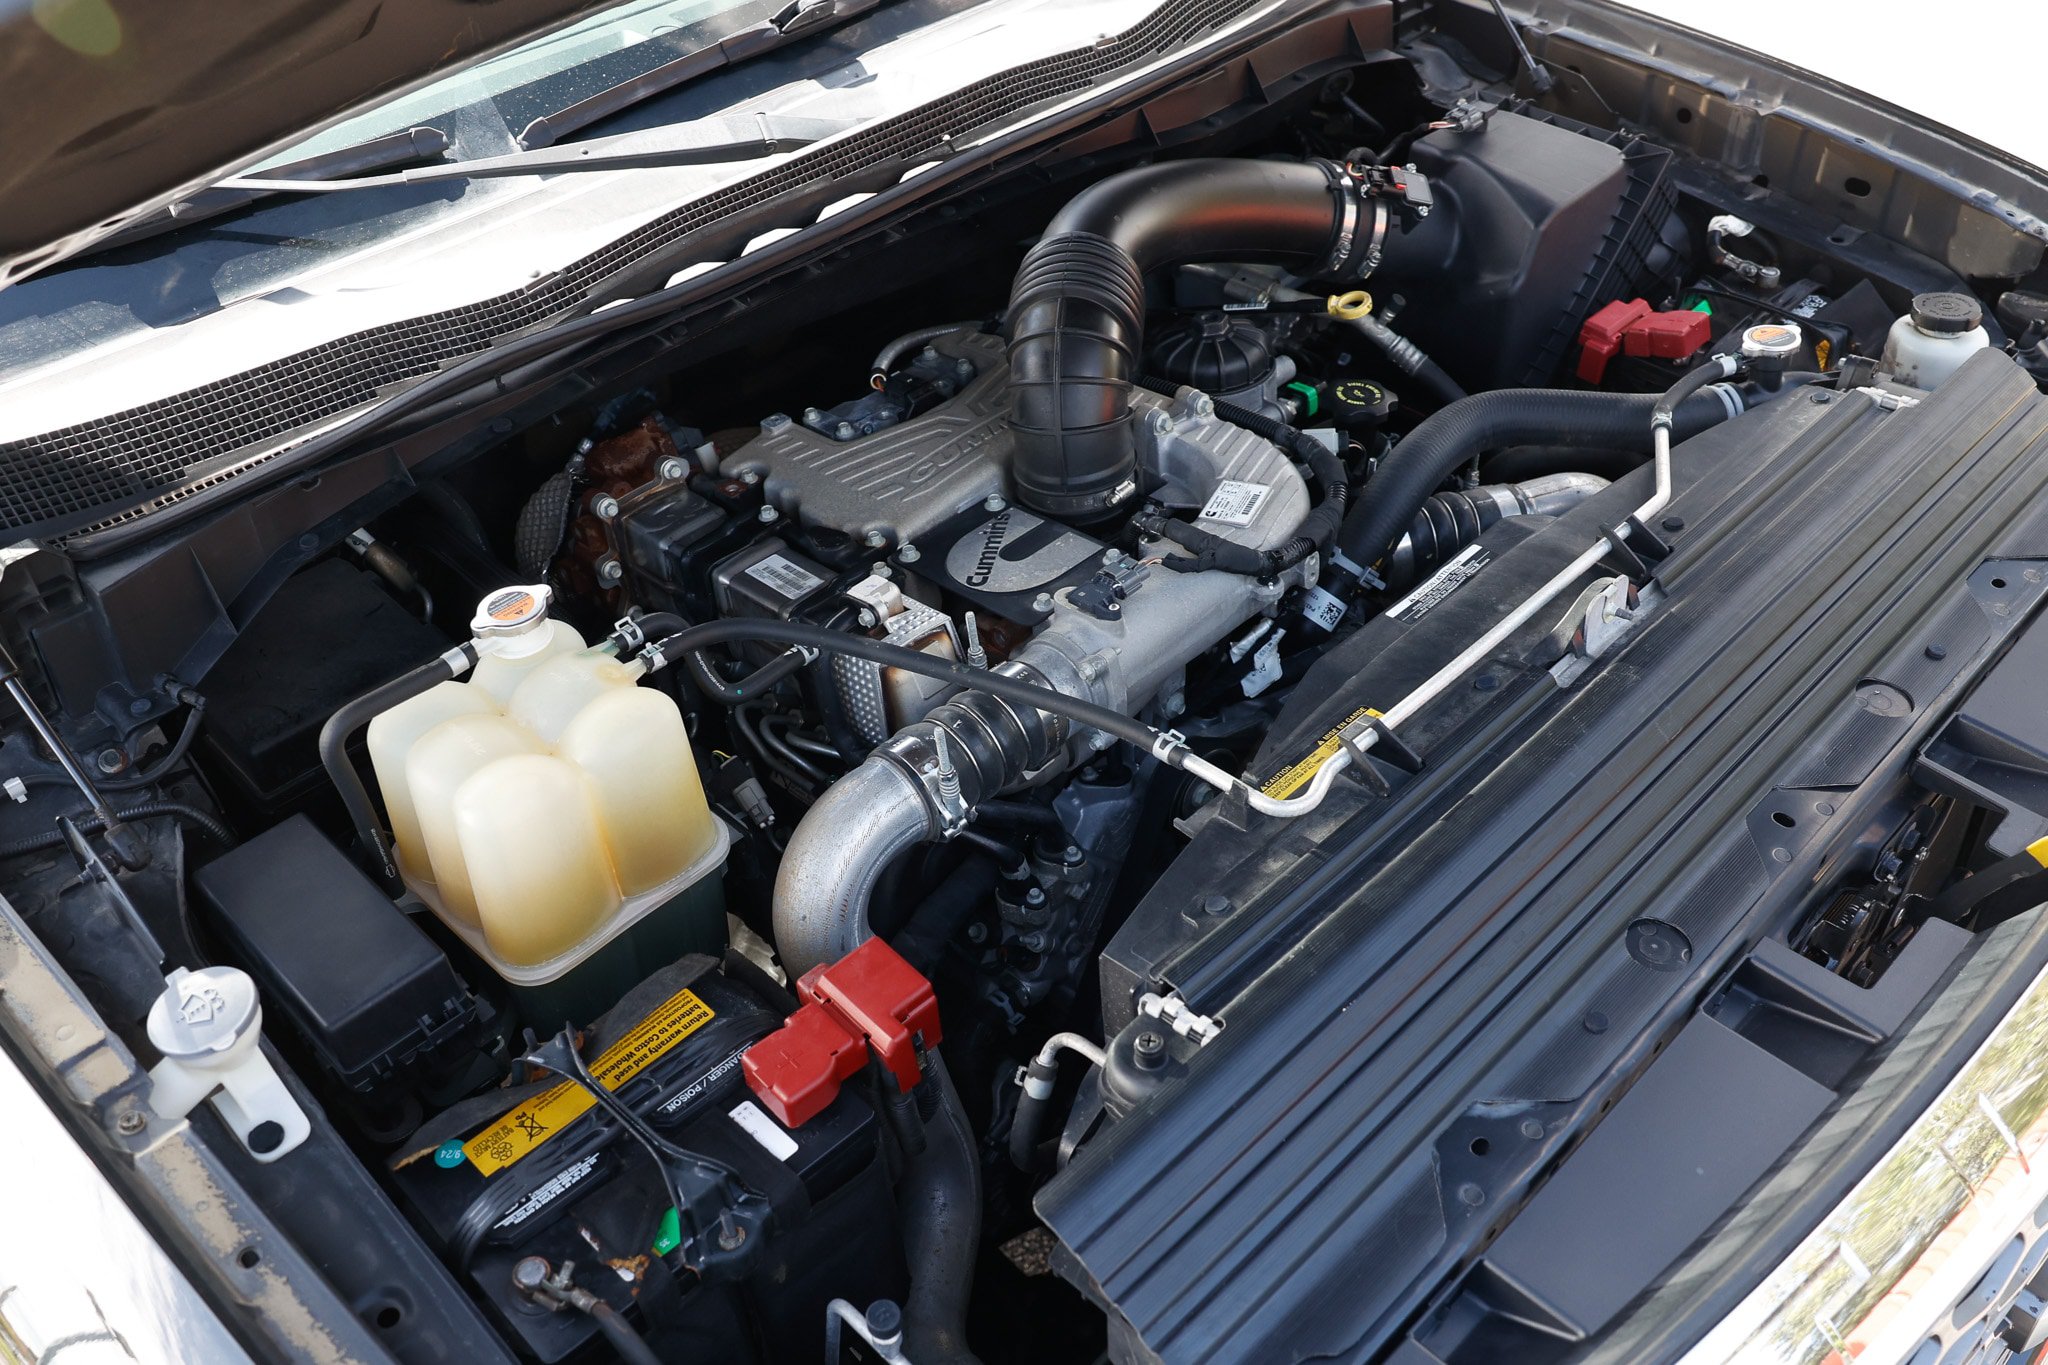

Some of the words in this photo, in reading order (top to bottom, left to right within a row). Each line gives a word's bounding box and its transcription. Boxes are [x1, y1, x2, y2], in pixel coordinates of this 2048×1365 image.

[966, 512, 1011, 590] Cummins
[1322, 726, 1339, 741] MISE
[1336, 720, 1347, 730] EN
[1344, 704, 1367, 724] GARDE
[1264, 762, 1293, 787] CAUTION
[666, 1002, 701, 1032] batteries
[680, 1008, 709, 1033] Return
[633, 1031, 661, 1056] Costco
[646, 1024, 684, 1057] warranty
[657, 1025, 670, 1039] to
[594, 1049, 637, 1085] Wholesale
[631, 1051, 650, 1069] and
[706, 1051, 744, 1082] DANGER
[612, 1063, 635, 1083] used
[665, 1082, 702, 1113] POISON
[513, 1110, 527, 1122] Pb
[439, 1148, 462, 1159] 9/24
